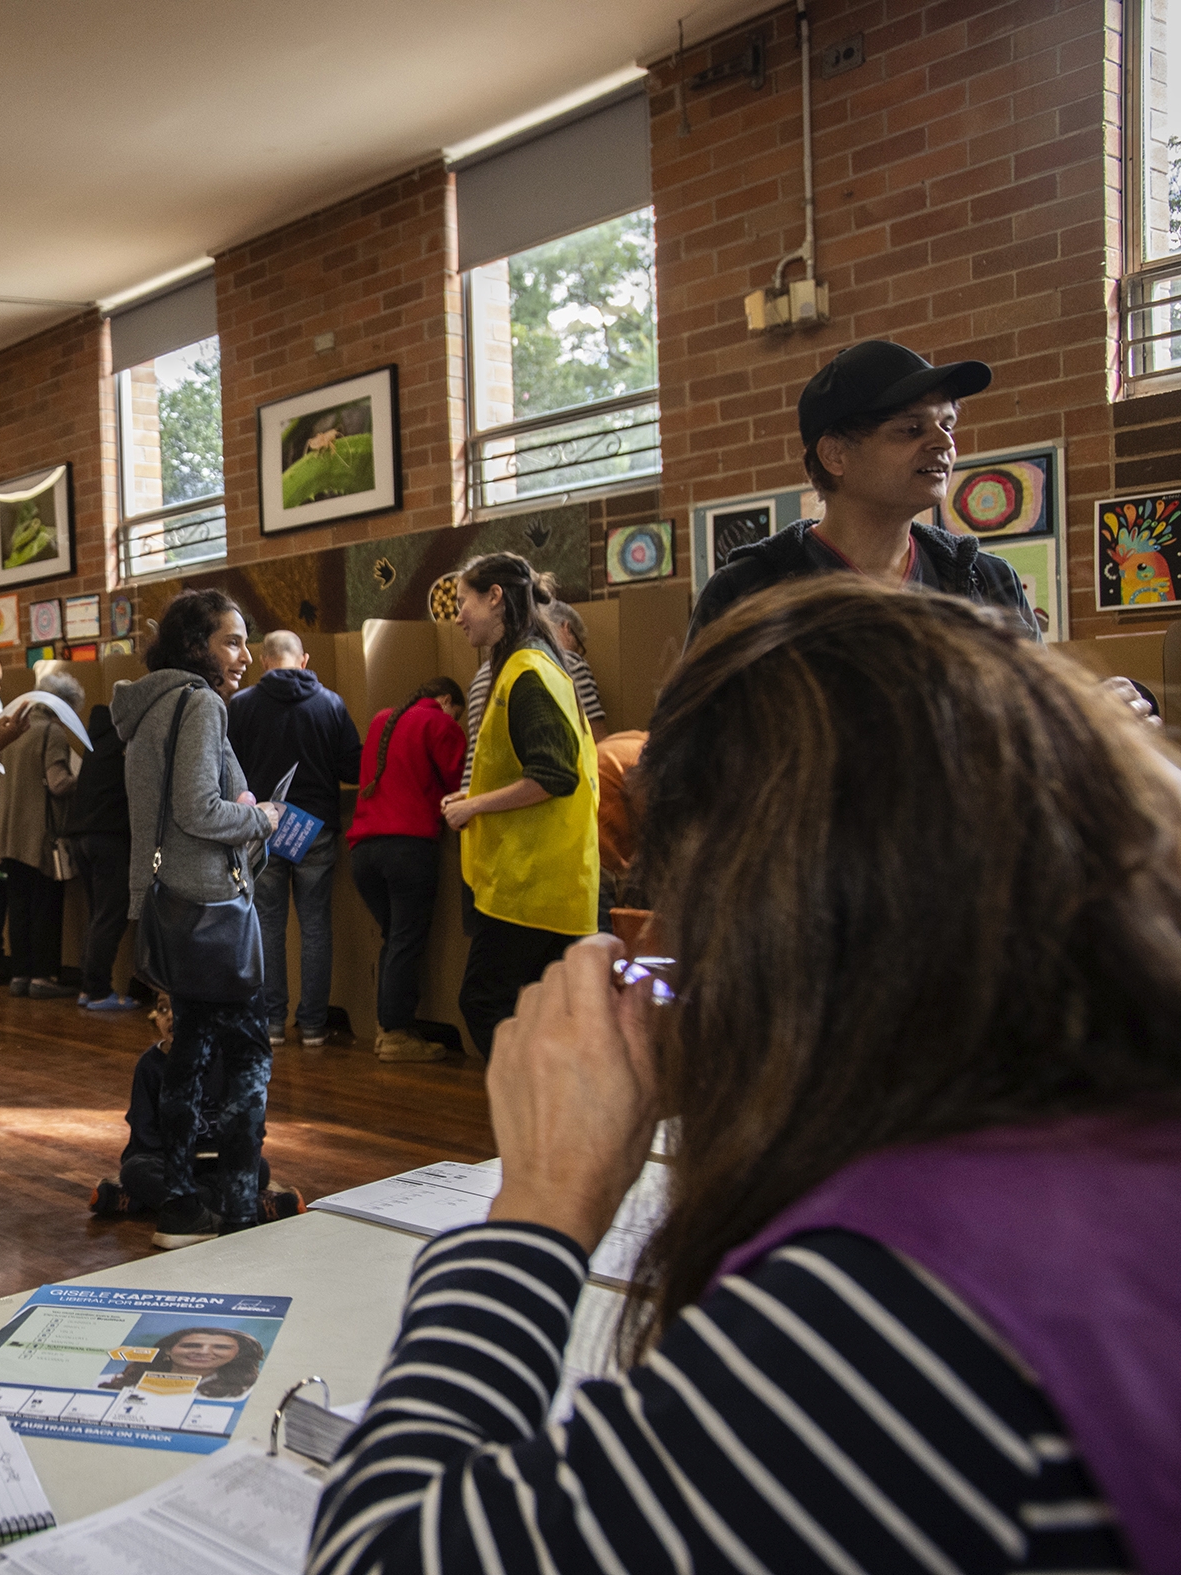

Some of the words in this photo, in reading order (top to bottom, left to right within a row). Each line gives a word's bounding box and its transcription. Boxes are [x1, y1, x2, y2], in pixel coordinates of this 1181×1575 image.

[286, 812, 297, 826] BACK
[273, 832, 286, 848] TRACK
[284, 822, 302, 846] AUSTRALIA
[50, 1289, 111, 1299] GISELE
[112, 1292, 224, 1305] KAPTERIAN
[134, 1300, 206, 1309] BRADFIELD
[20, 1422, 83, 1434] AUSTRALIA
[84, 1428, 114, 1437] BACK
[134, 1433, 172, 1442] TRACK
